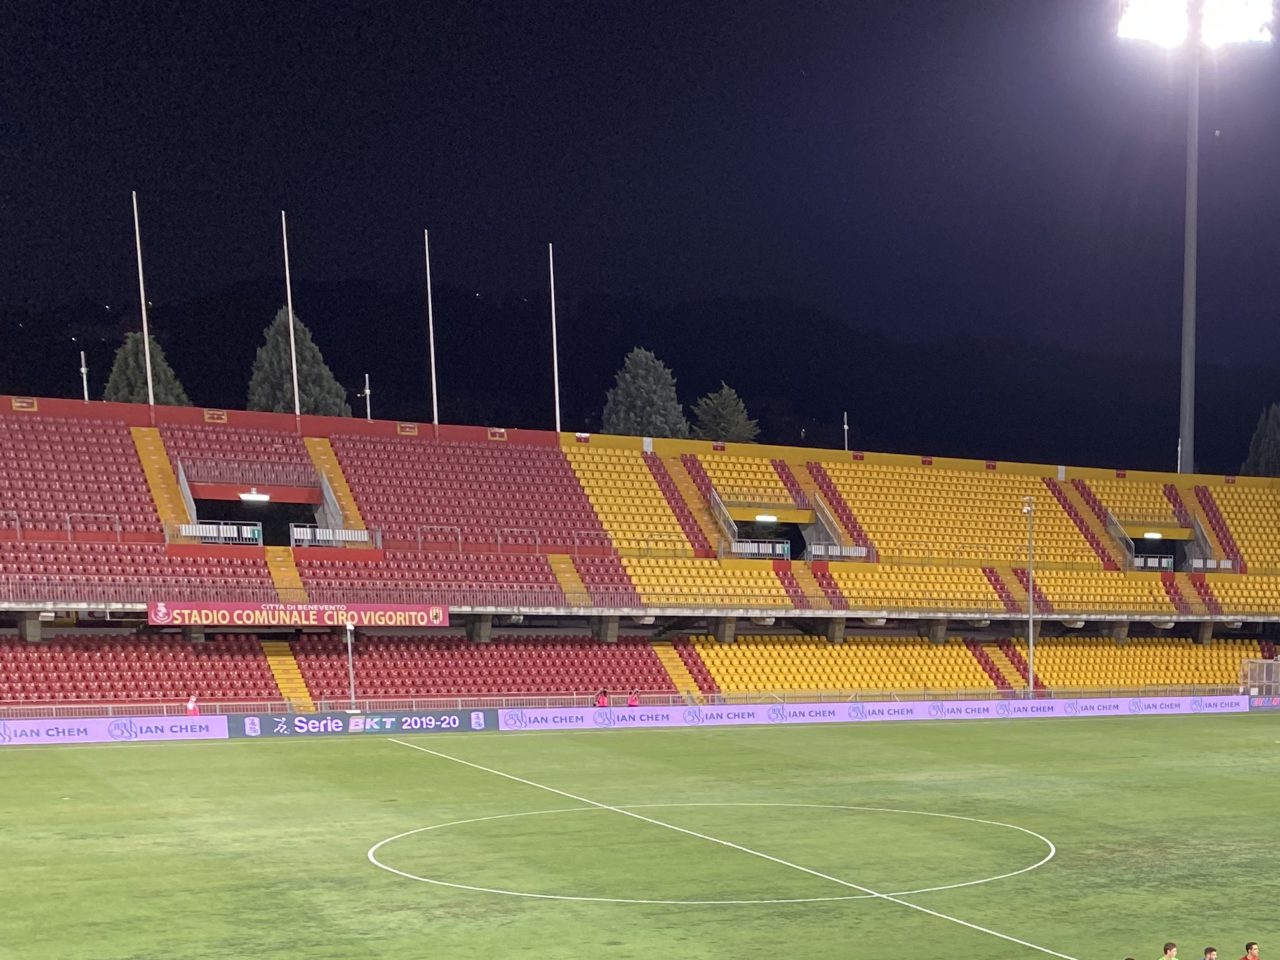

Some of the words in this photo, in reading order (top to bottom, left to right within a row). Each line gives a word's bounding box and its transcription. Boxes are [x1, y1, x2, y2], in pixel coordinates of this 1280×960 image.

[173, 609, 230, 625] STADIO
[234, 610, 318, 626] COMUNALE
[324, 610, 358, 626] CIRO
[362, 611, 428, 626] VIGORITO
[170, 724, 210, 734] CHEM
[294, 716, 343, 732] Serie
[349, 716, 396, 732] BKT
[402, 716, 460, 729] 2019-20
